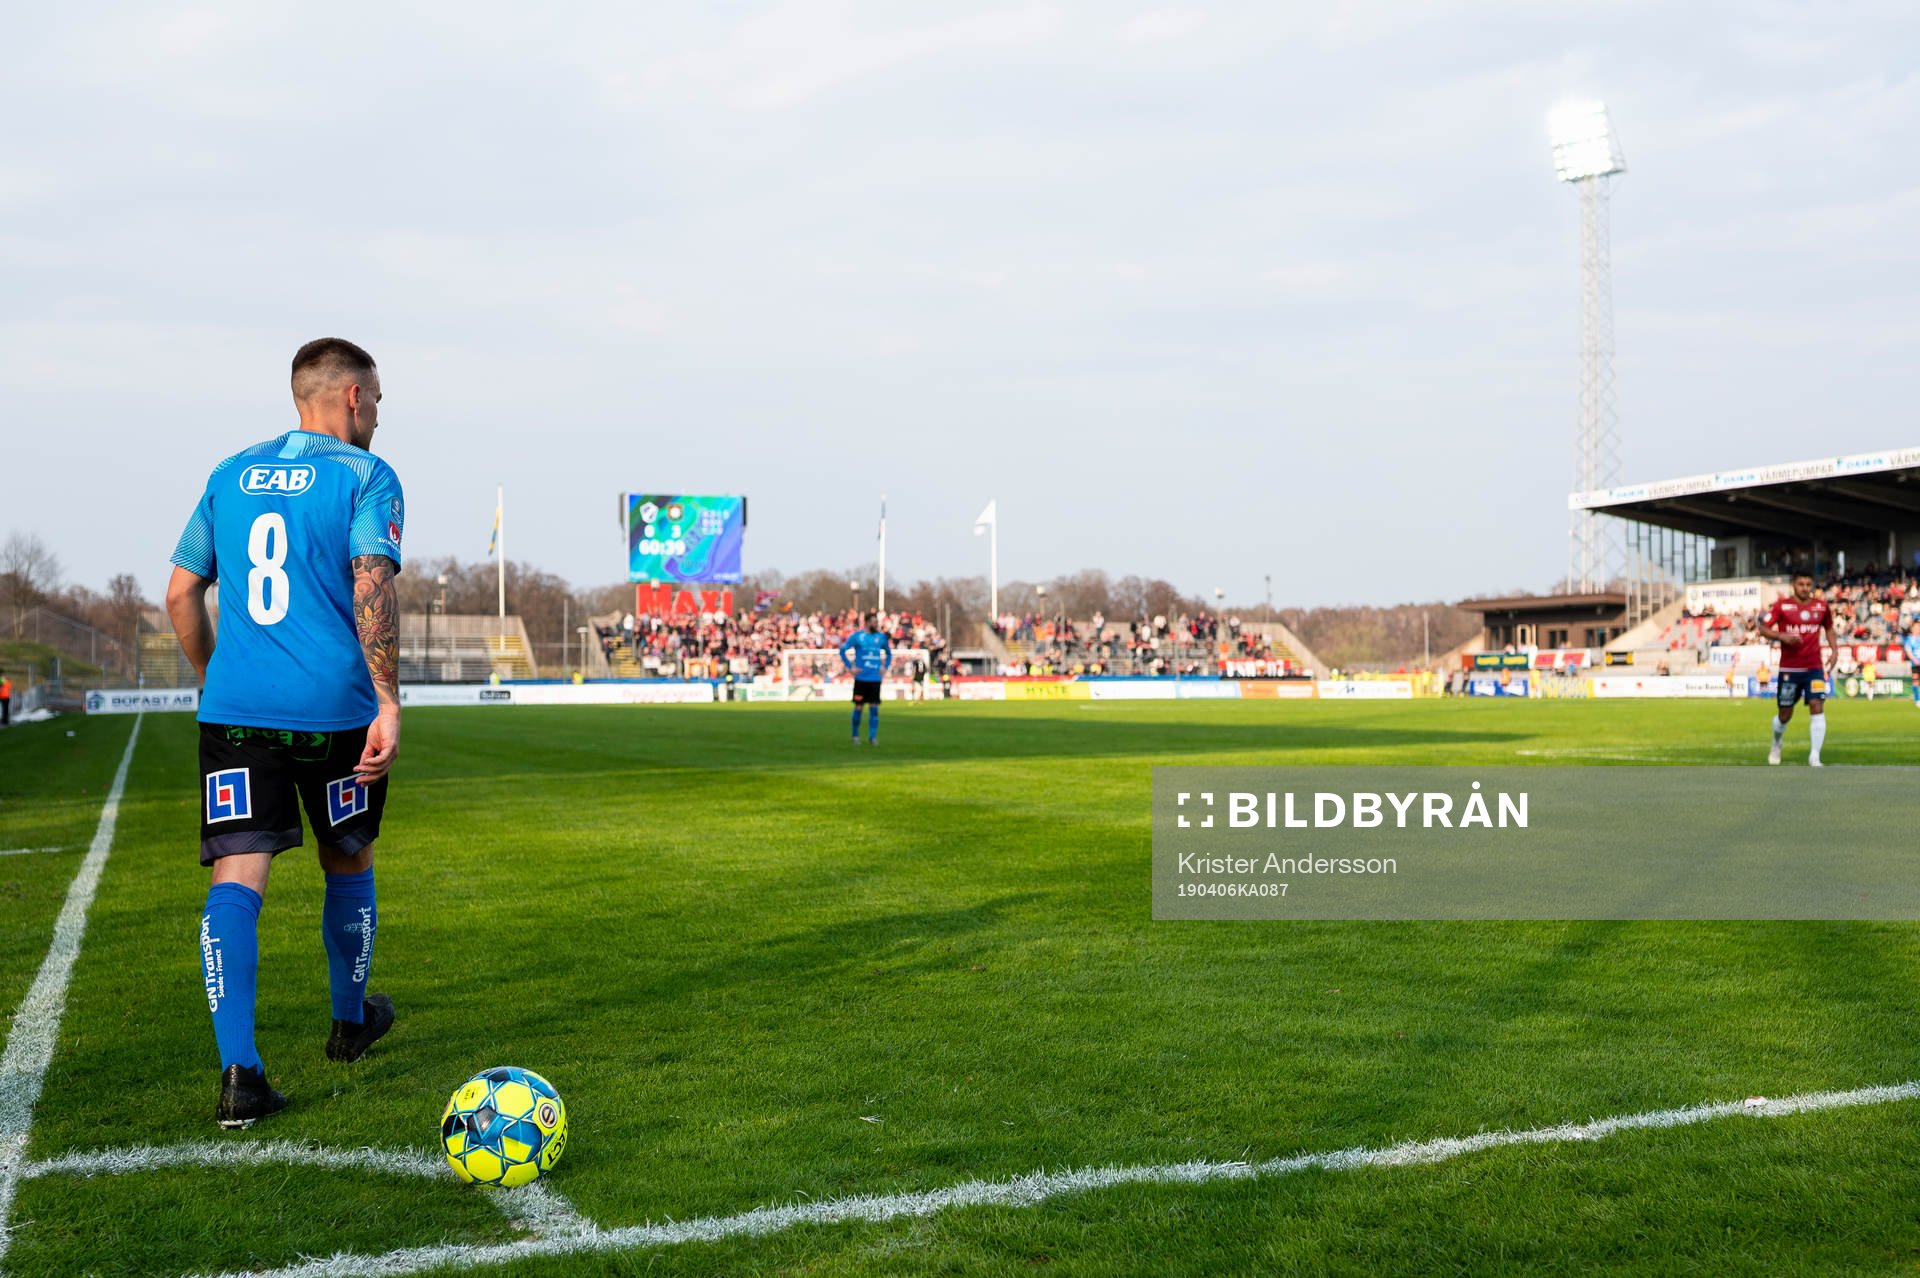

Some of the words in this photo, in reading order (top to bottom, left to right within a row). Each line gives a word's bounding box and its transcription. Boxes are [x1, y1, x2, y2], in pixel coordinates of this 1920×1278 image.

[247, 469, 309, 490] EAB
[248, 512, 289, 625] 8
[637, 584, 733, 616] MAXI
[111, 695, 168, 706] BOFAST
[173, 695, 192, 705] AB
[356, 906, 376, 964] Transport
[215, 949, 223, 972] France
[352, 963, 366, 983] GN
[207, 986, 219, 1013] GN
